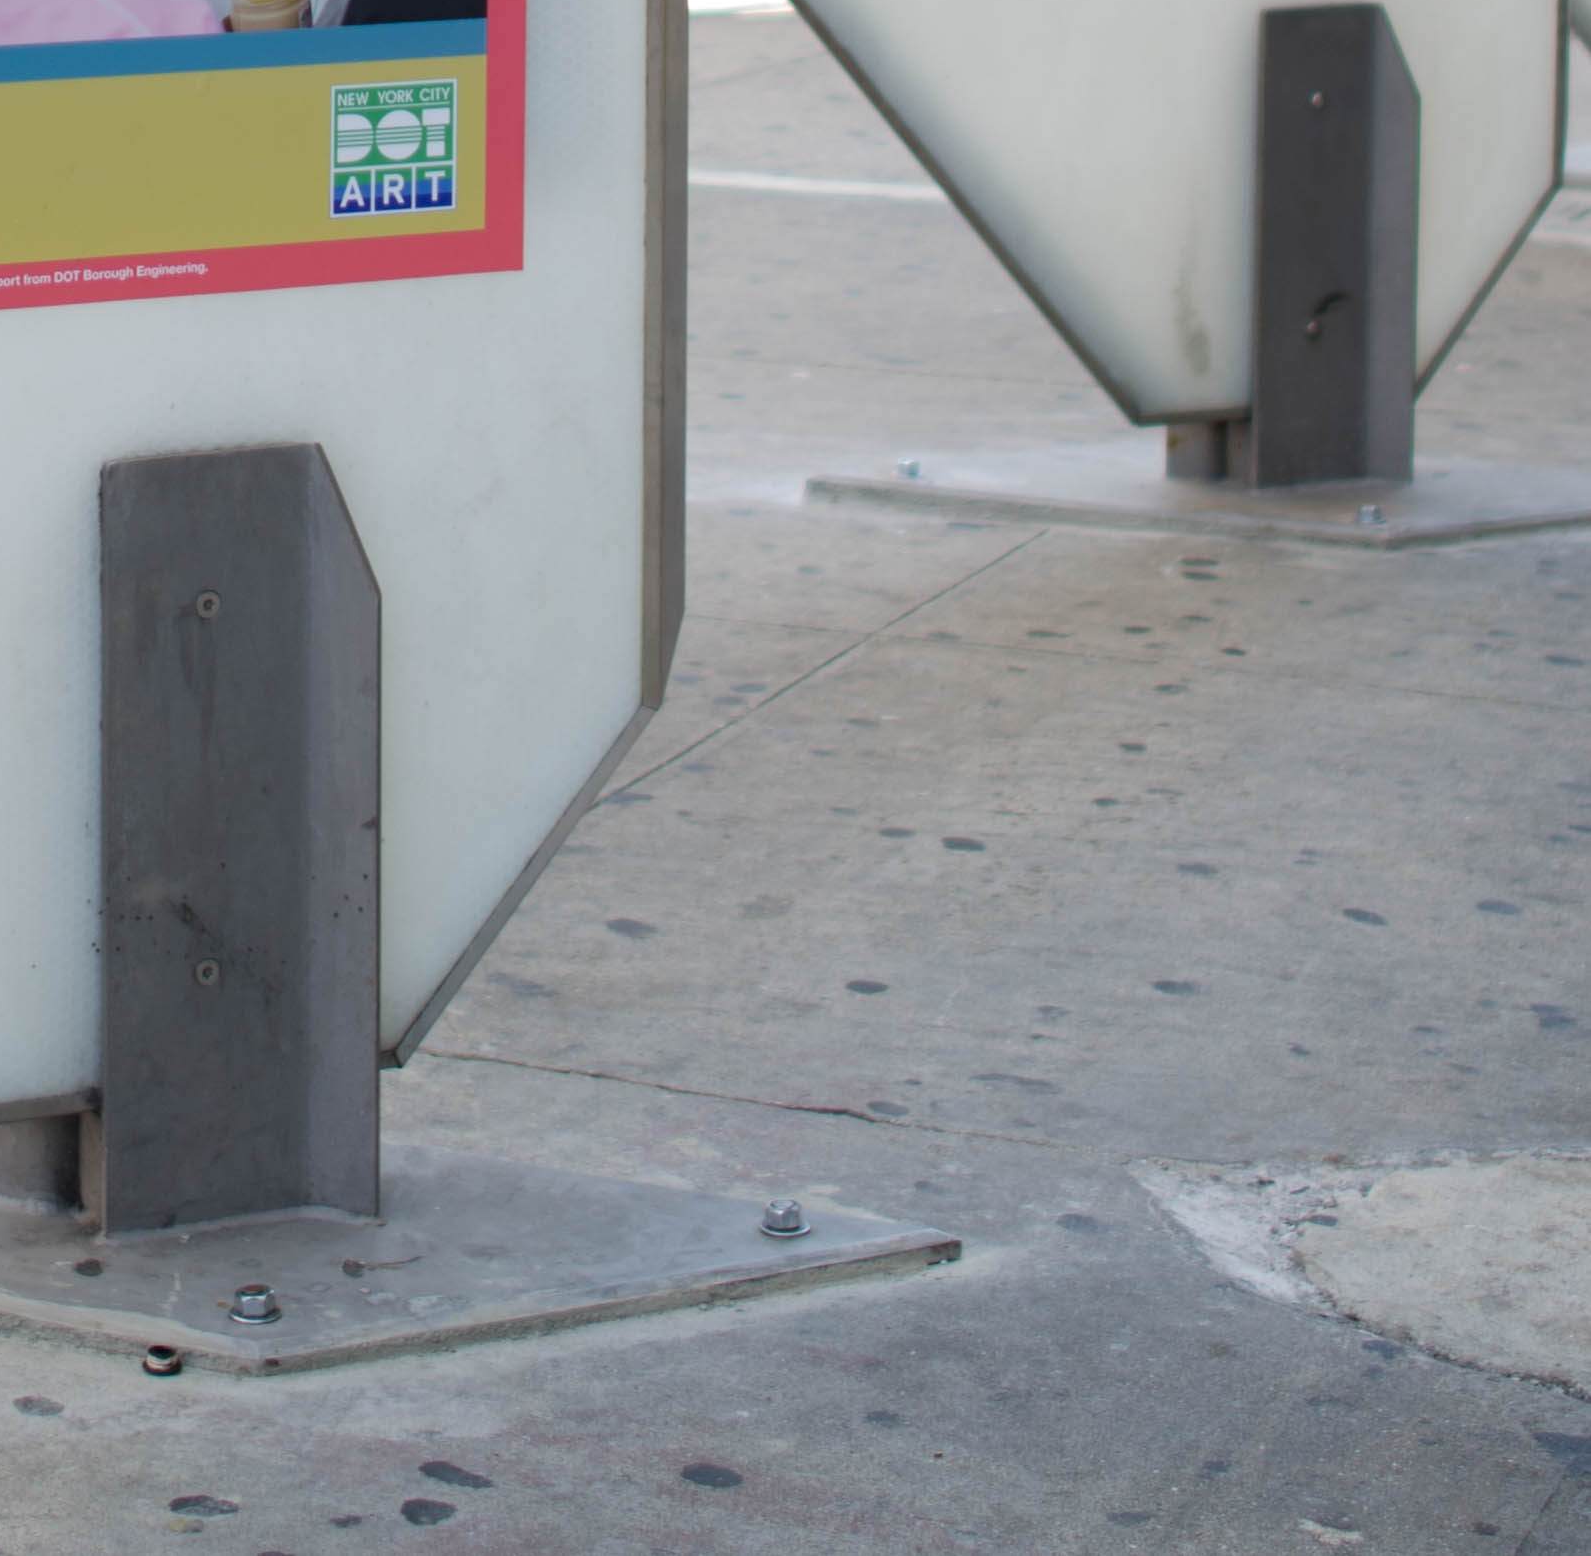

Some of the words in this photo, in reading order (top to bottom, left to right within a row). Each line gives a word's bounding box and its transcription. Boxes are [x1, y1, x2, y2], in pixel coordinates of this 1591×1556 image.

[337, 91, 369, 107] NEW
[377, 88, 414, 104] YORK
[419, 86, 451, 102] CITY
[336, 107, 451, 164] DOT
[339, 170, 447, 209] ART
[22, 273, 52, 286] from
[53, 269, 82, 284] DOT
[82, 265, 135, 282] Borough
[135, 261, 209, 279] Engineering.
